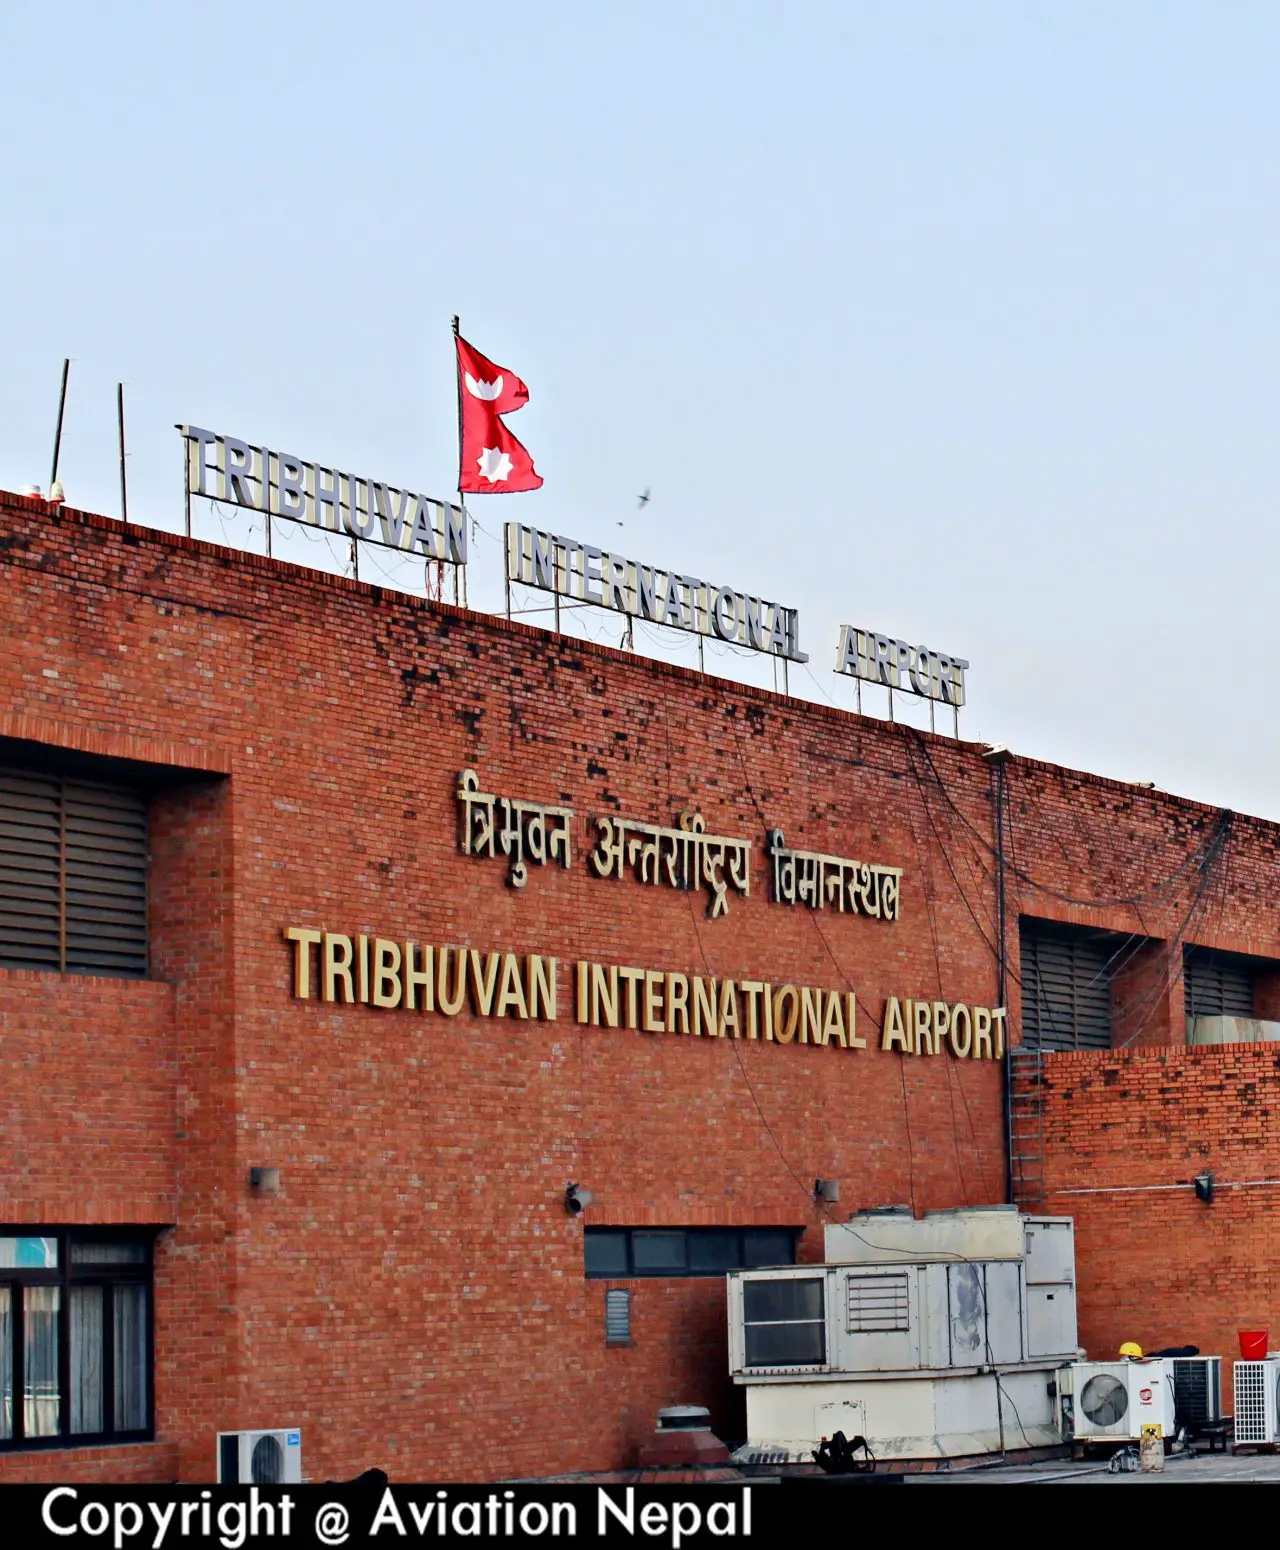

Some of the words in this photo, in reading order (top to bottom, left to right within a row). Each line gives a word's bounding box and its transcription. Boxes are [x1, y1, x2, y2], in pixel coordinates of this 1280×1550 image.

[180, 425, 468, 565] TRIBHUVAN
[498, 522, 809, 663] INTERNATIONAL
[836, 625, 970, 707] AIRPORT
[457, 769, 575, 888] त्रिभुवन
[770, 828, 903, 921] विमानस्थल
[285, 926, 557, 1021] TRIBHUVAN
[576, 960, 867, 1050] INTERNATIONAL
[882, 996, 1007, 1060] AIRPORT
